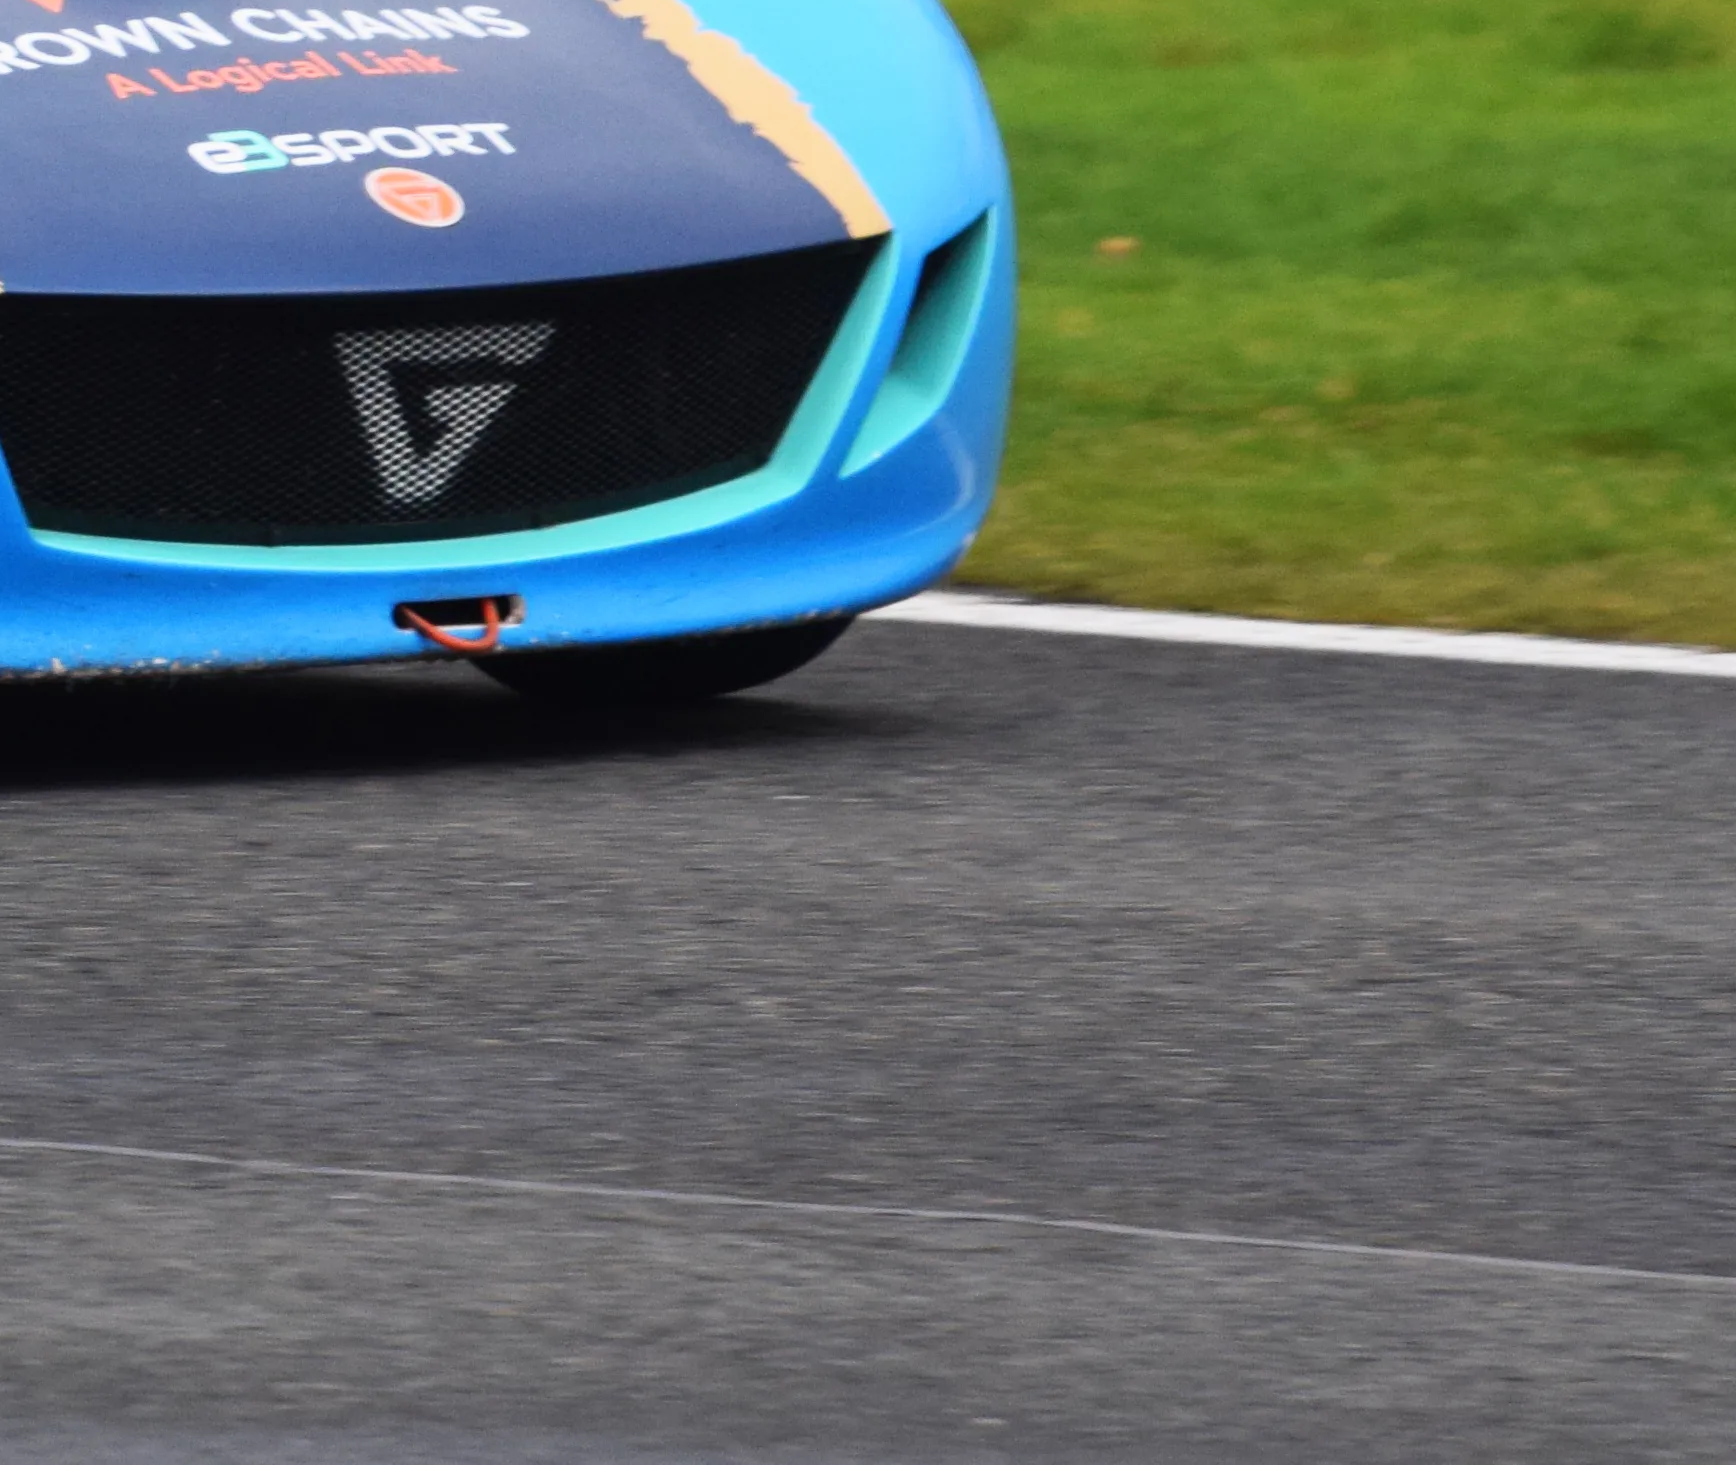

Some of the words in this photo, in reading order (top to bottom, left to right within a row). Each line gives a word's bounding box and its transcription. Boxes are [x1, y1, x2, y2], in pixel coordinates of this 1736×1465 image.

[231, 5, 531, 43] CHAINS
[105, 72, 156, 99] A
[151, 51, 342, 93] Logical
[337, 49, 458, 76] Link
